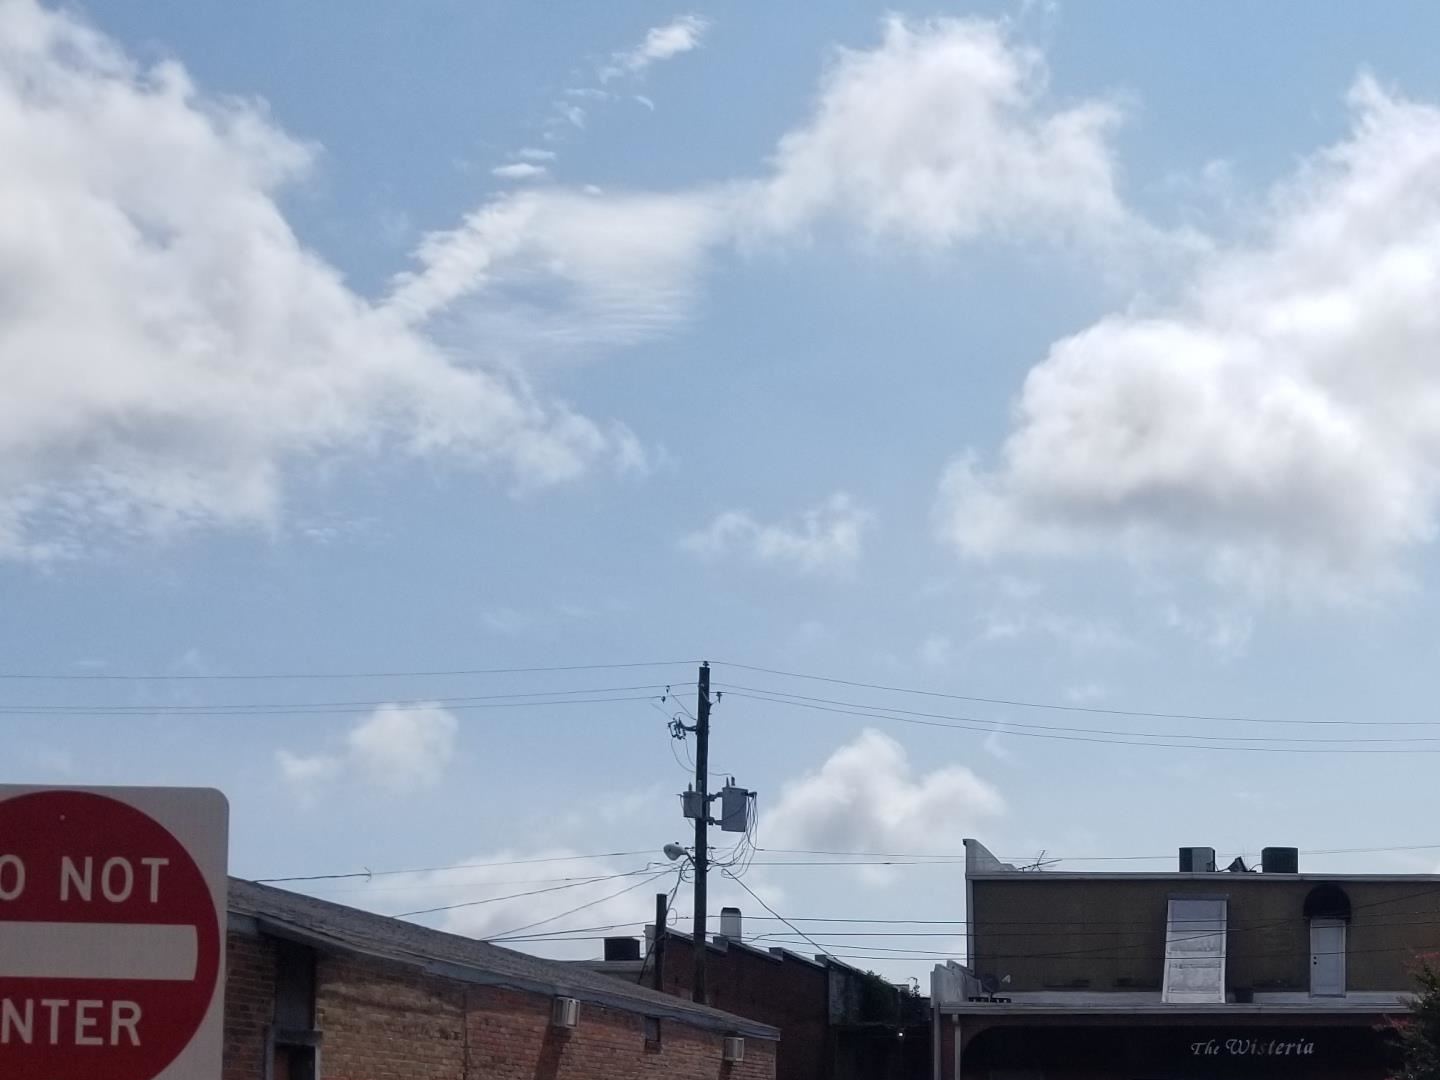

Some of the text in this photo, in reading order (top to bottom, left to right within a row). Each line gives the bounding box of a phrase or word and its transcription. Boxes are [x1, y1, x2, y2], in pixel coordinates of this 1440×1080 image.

[0, 855, 169, 903] O NOT
[0, 998, 142, 1046] NTER
[1191, 1038, 1315, 1056] The Wisteria
